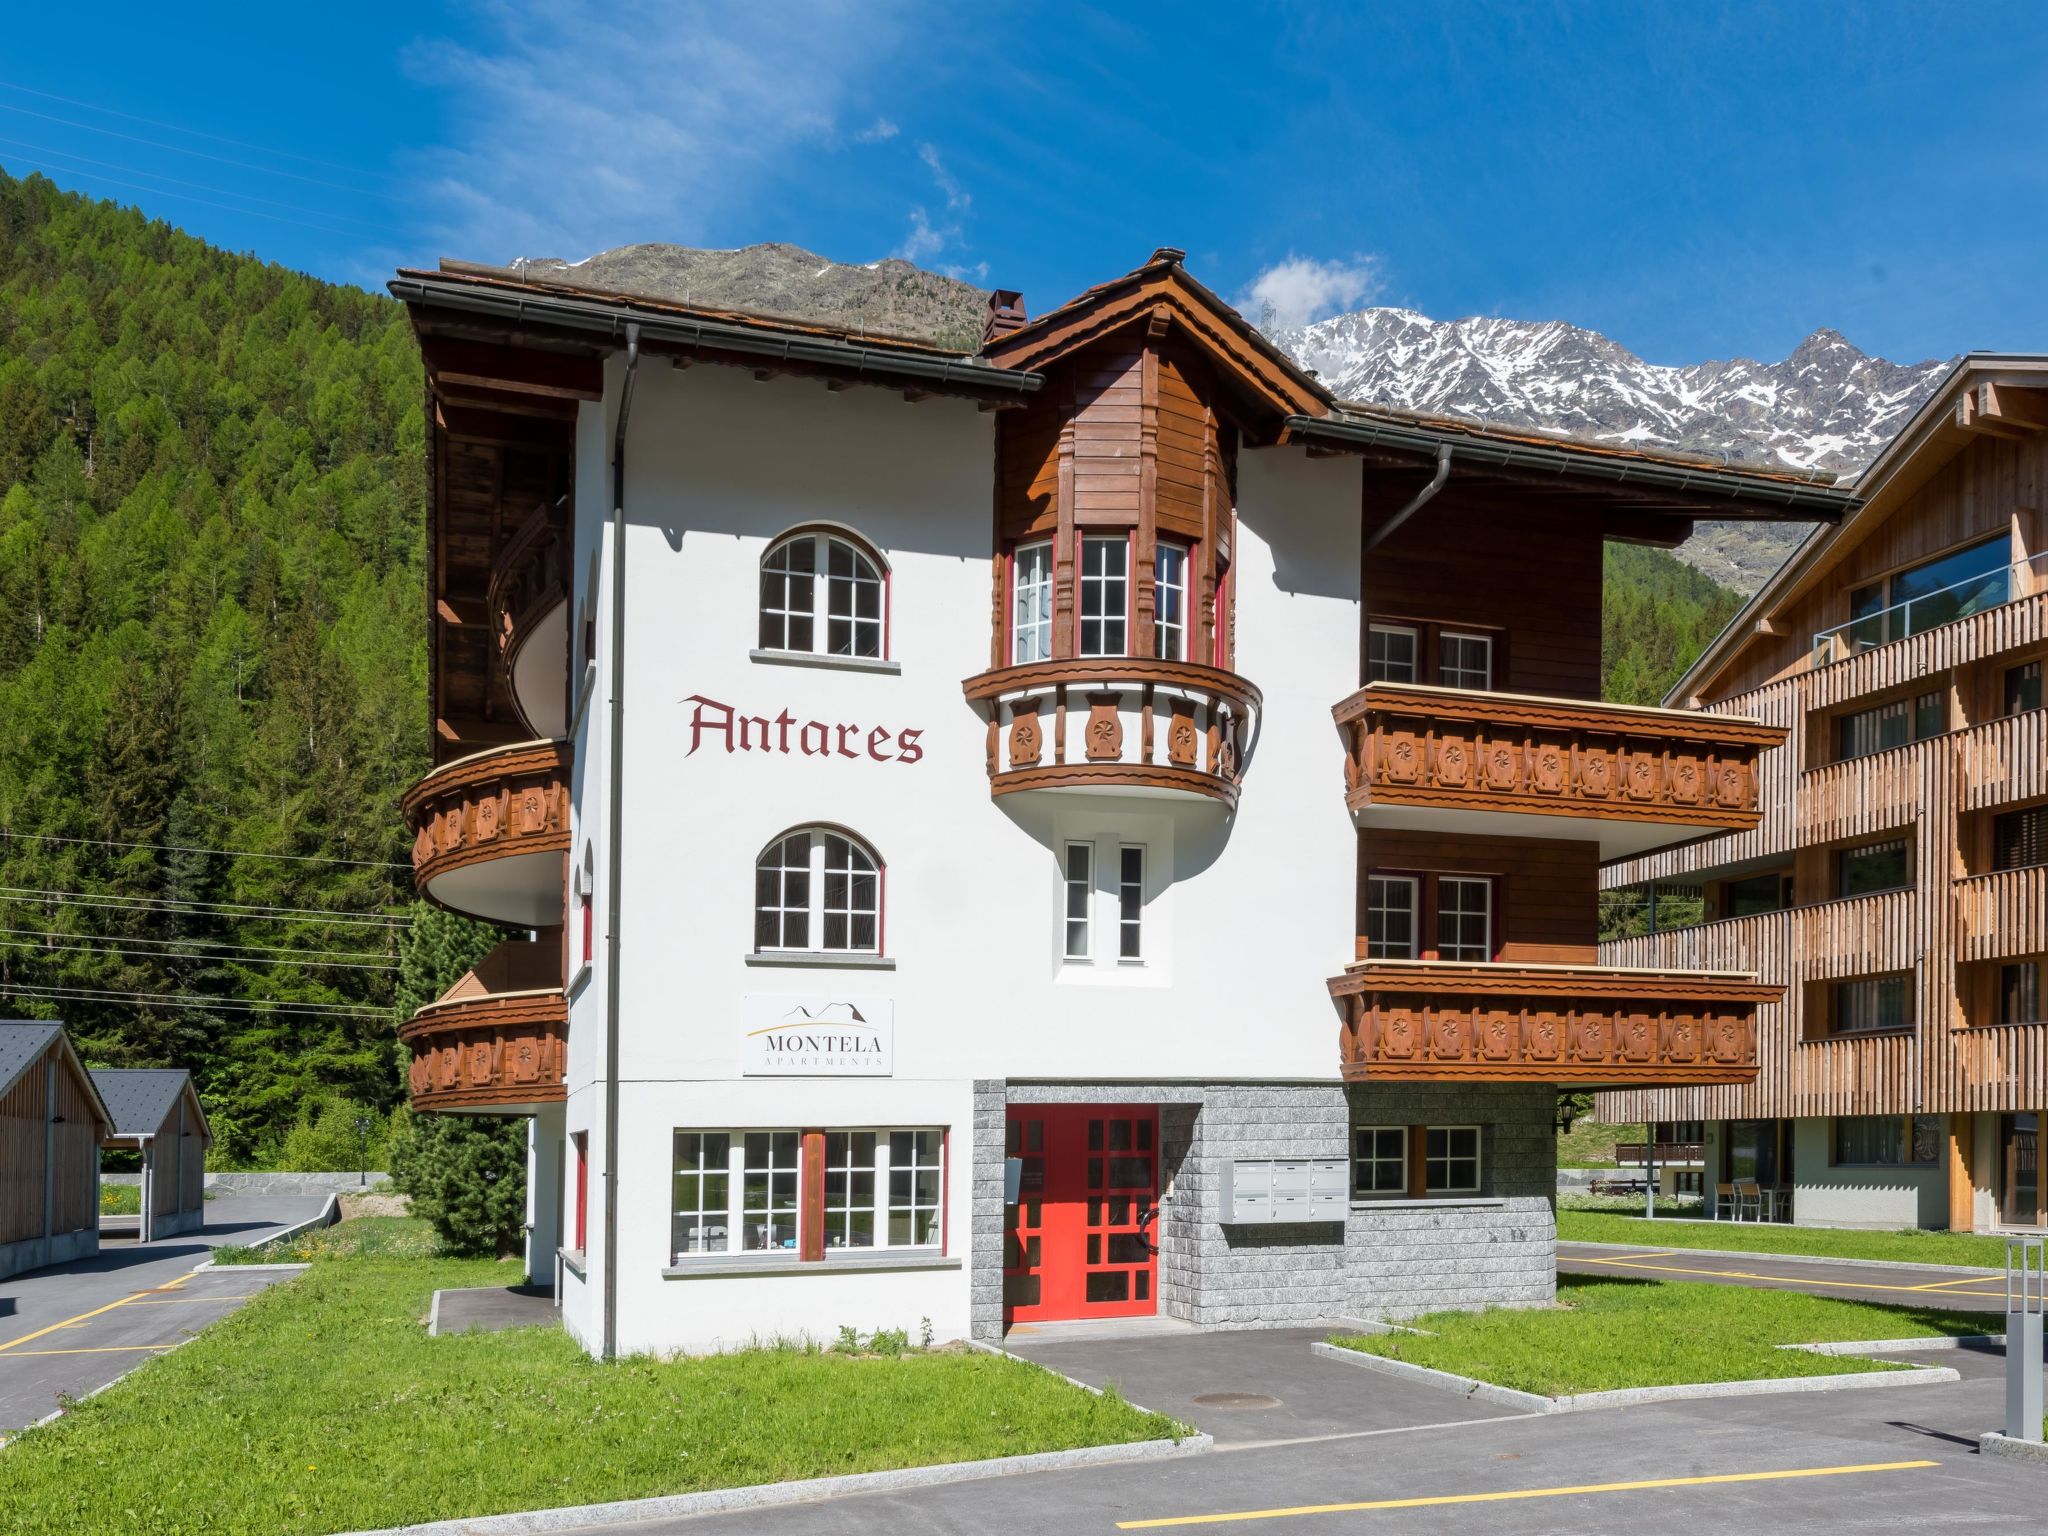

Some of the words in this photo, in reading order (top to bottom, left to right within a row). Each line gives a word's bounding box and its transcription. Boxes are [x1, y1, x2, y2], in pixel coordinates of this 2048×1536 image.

[678, 694, 924, 764] Antares
[765, 1035, 881, 1052] MONTELA
[765, 1057, 882, 1065] APARTMENTS
